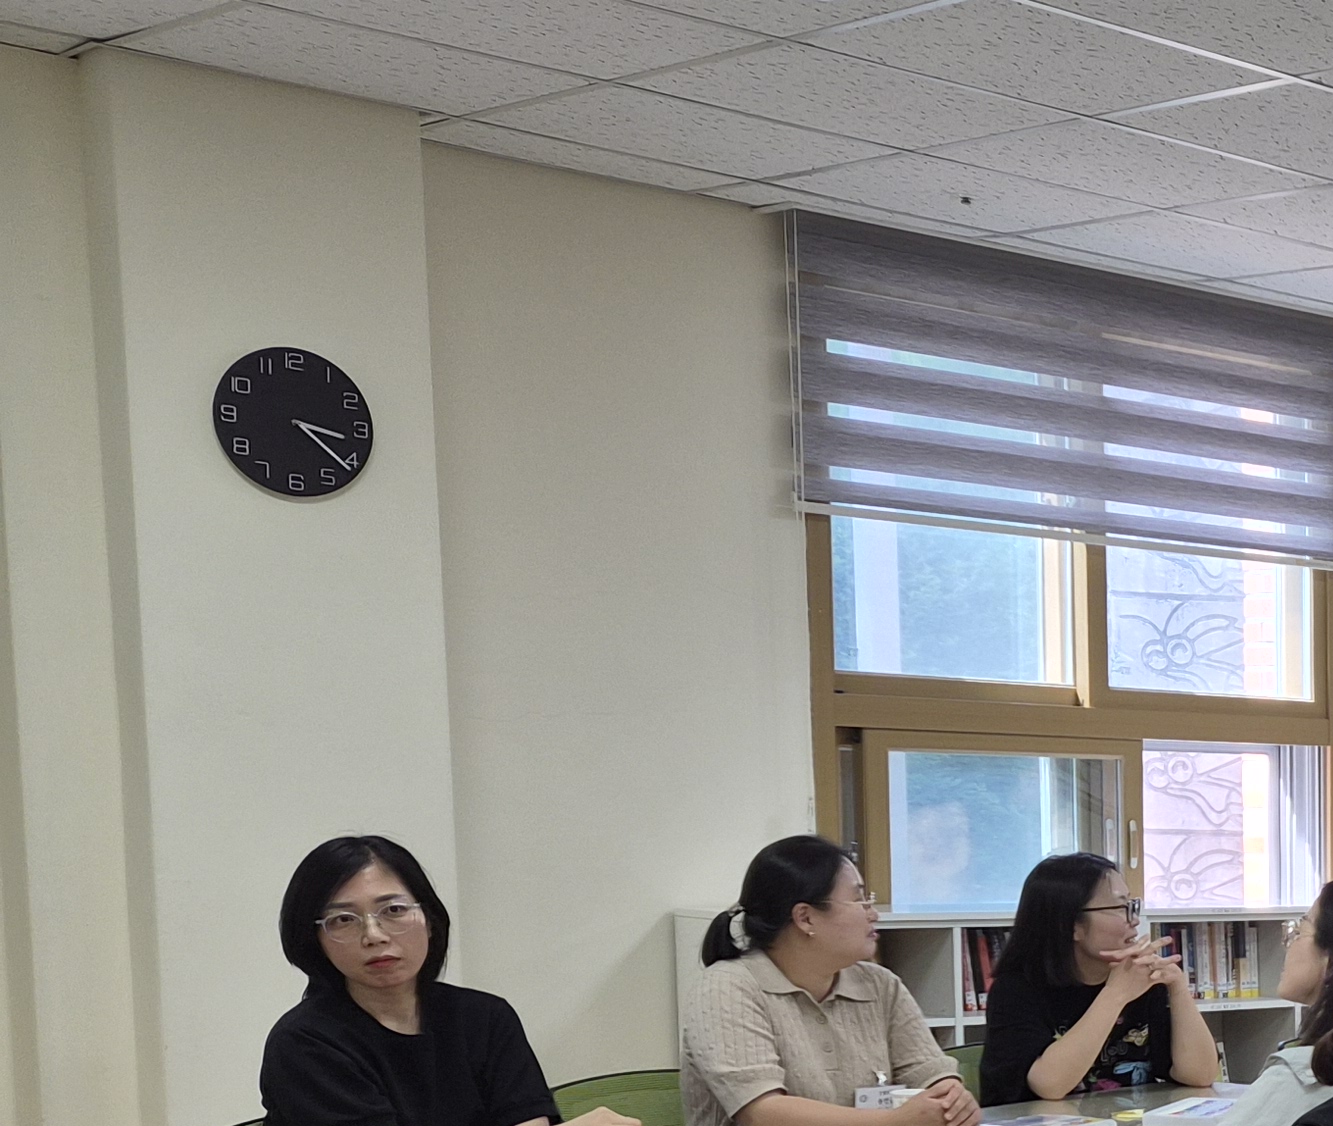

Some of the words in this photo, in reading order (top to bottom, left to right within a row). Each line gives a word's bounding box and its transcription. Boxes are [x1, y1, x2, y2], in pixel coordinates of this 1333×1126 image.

[259, 357, 273, 375] 11
[284, 352, 305, 371] 12
[325, 366, 331, 383] 1
[230, 376, 251, 394] 10
[342, 392, 359, 410] 2
[220, 404, 237, 422] 9
[353, 421, 369, 439] 3
[232, 437, 250, 455] 8
[254, 460, 270, 479] 7
[344, 452, 359, 469] 4
[288, 473, 305, 491] 6
[320, 468, 336, 486] 5
